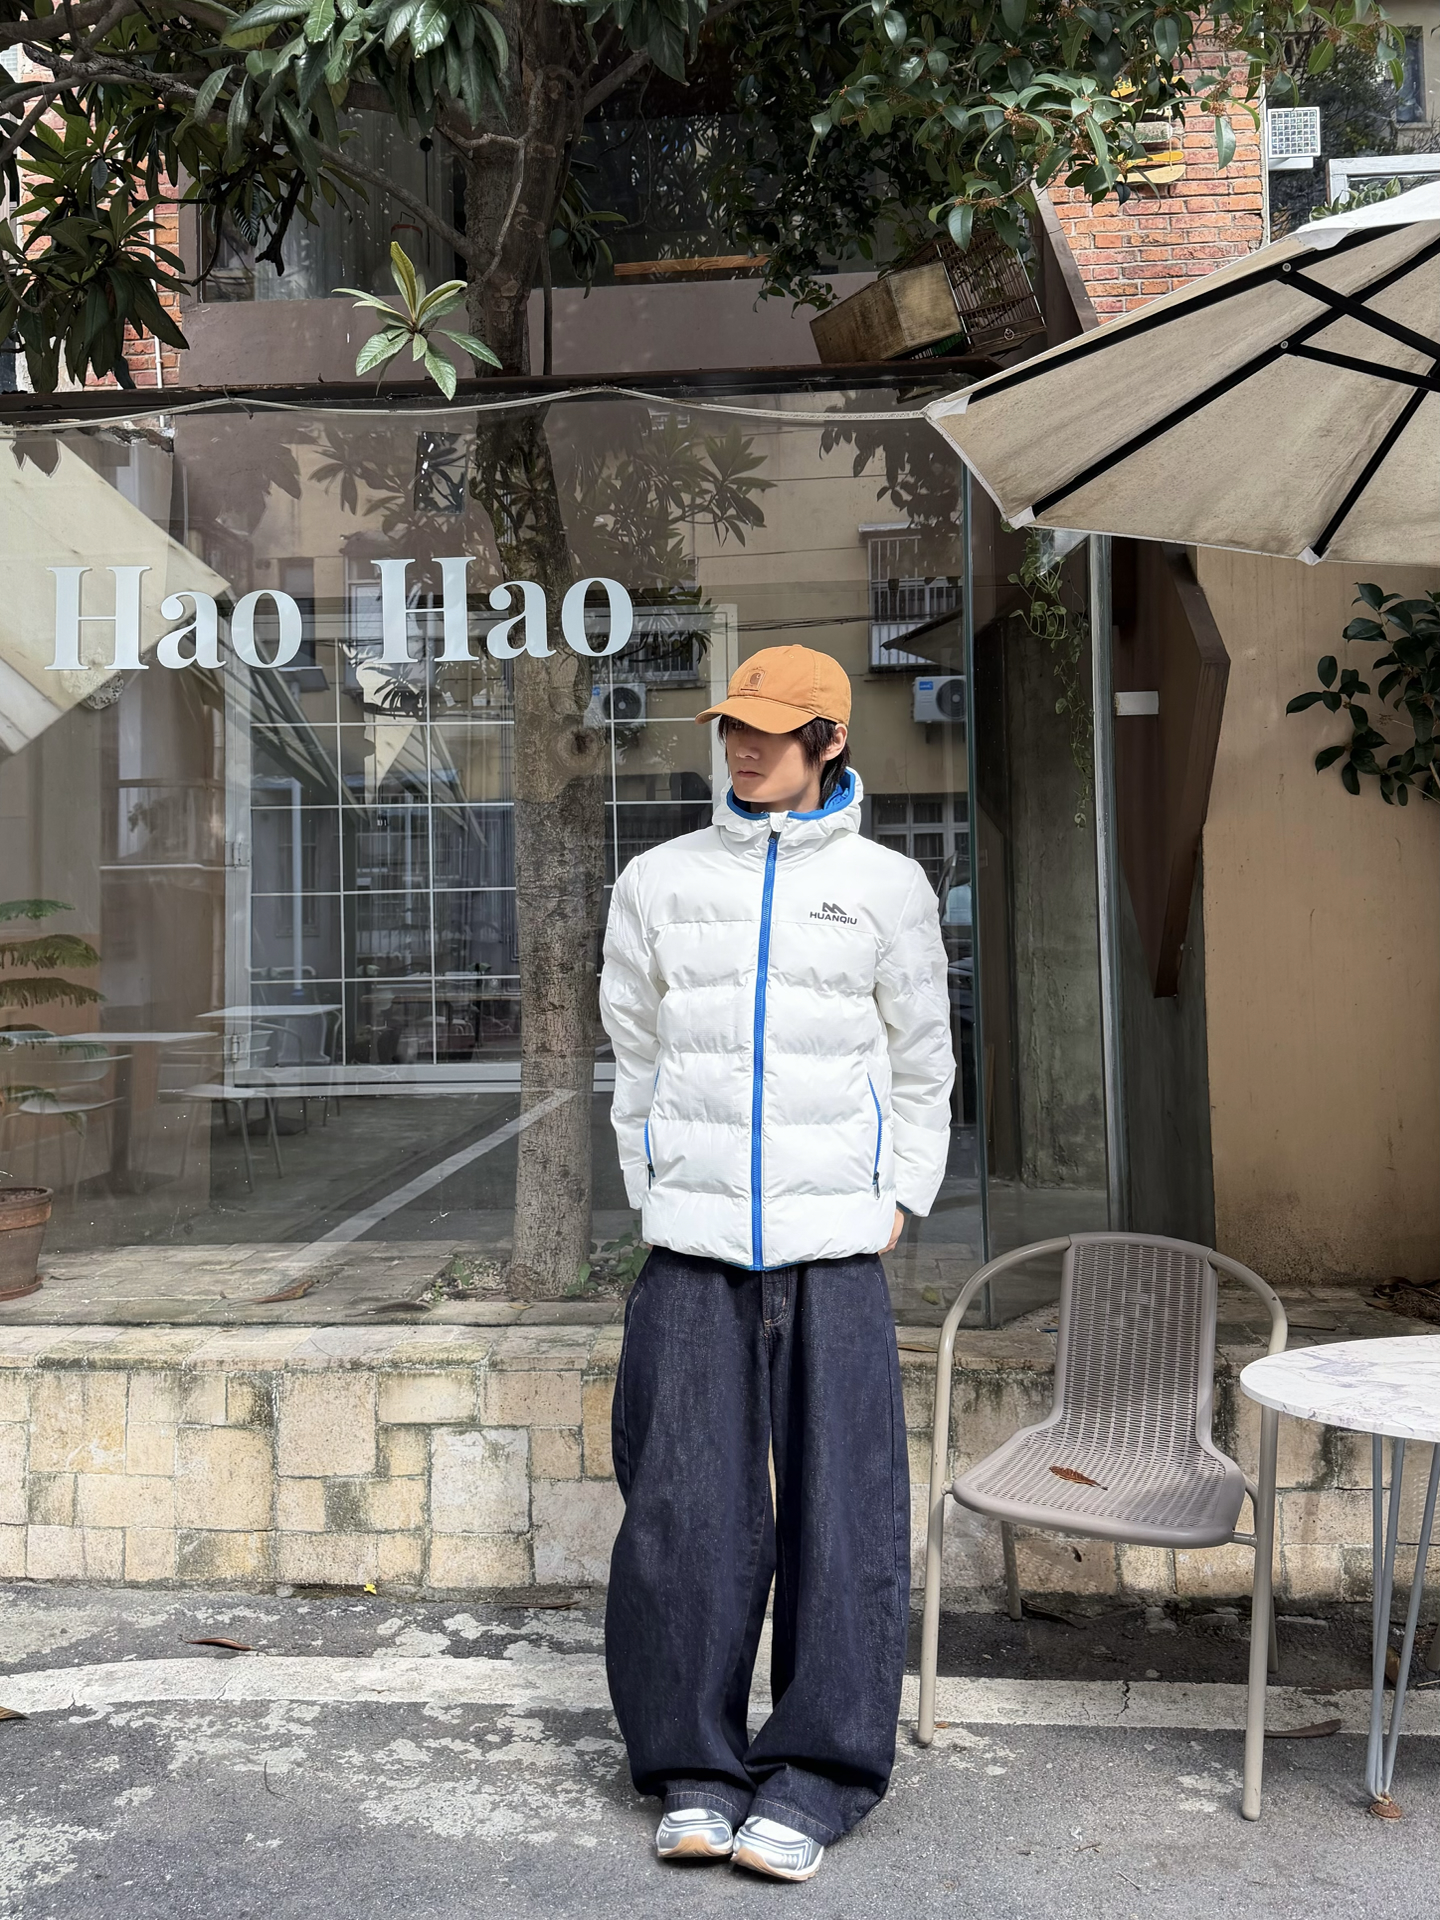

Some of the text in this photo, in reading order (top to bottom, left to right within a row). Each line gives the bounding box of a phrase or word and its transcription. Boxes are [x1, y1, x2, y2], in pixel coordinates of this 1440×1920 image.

[44, 556, 633, 670] Hao Hao
[809, 911, 858, 925] HUANQIU
